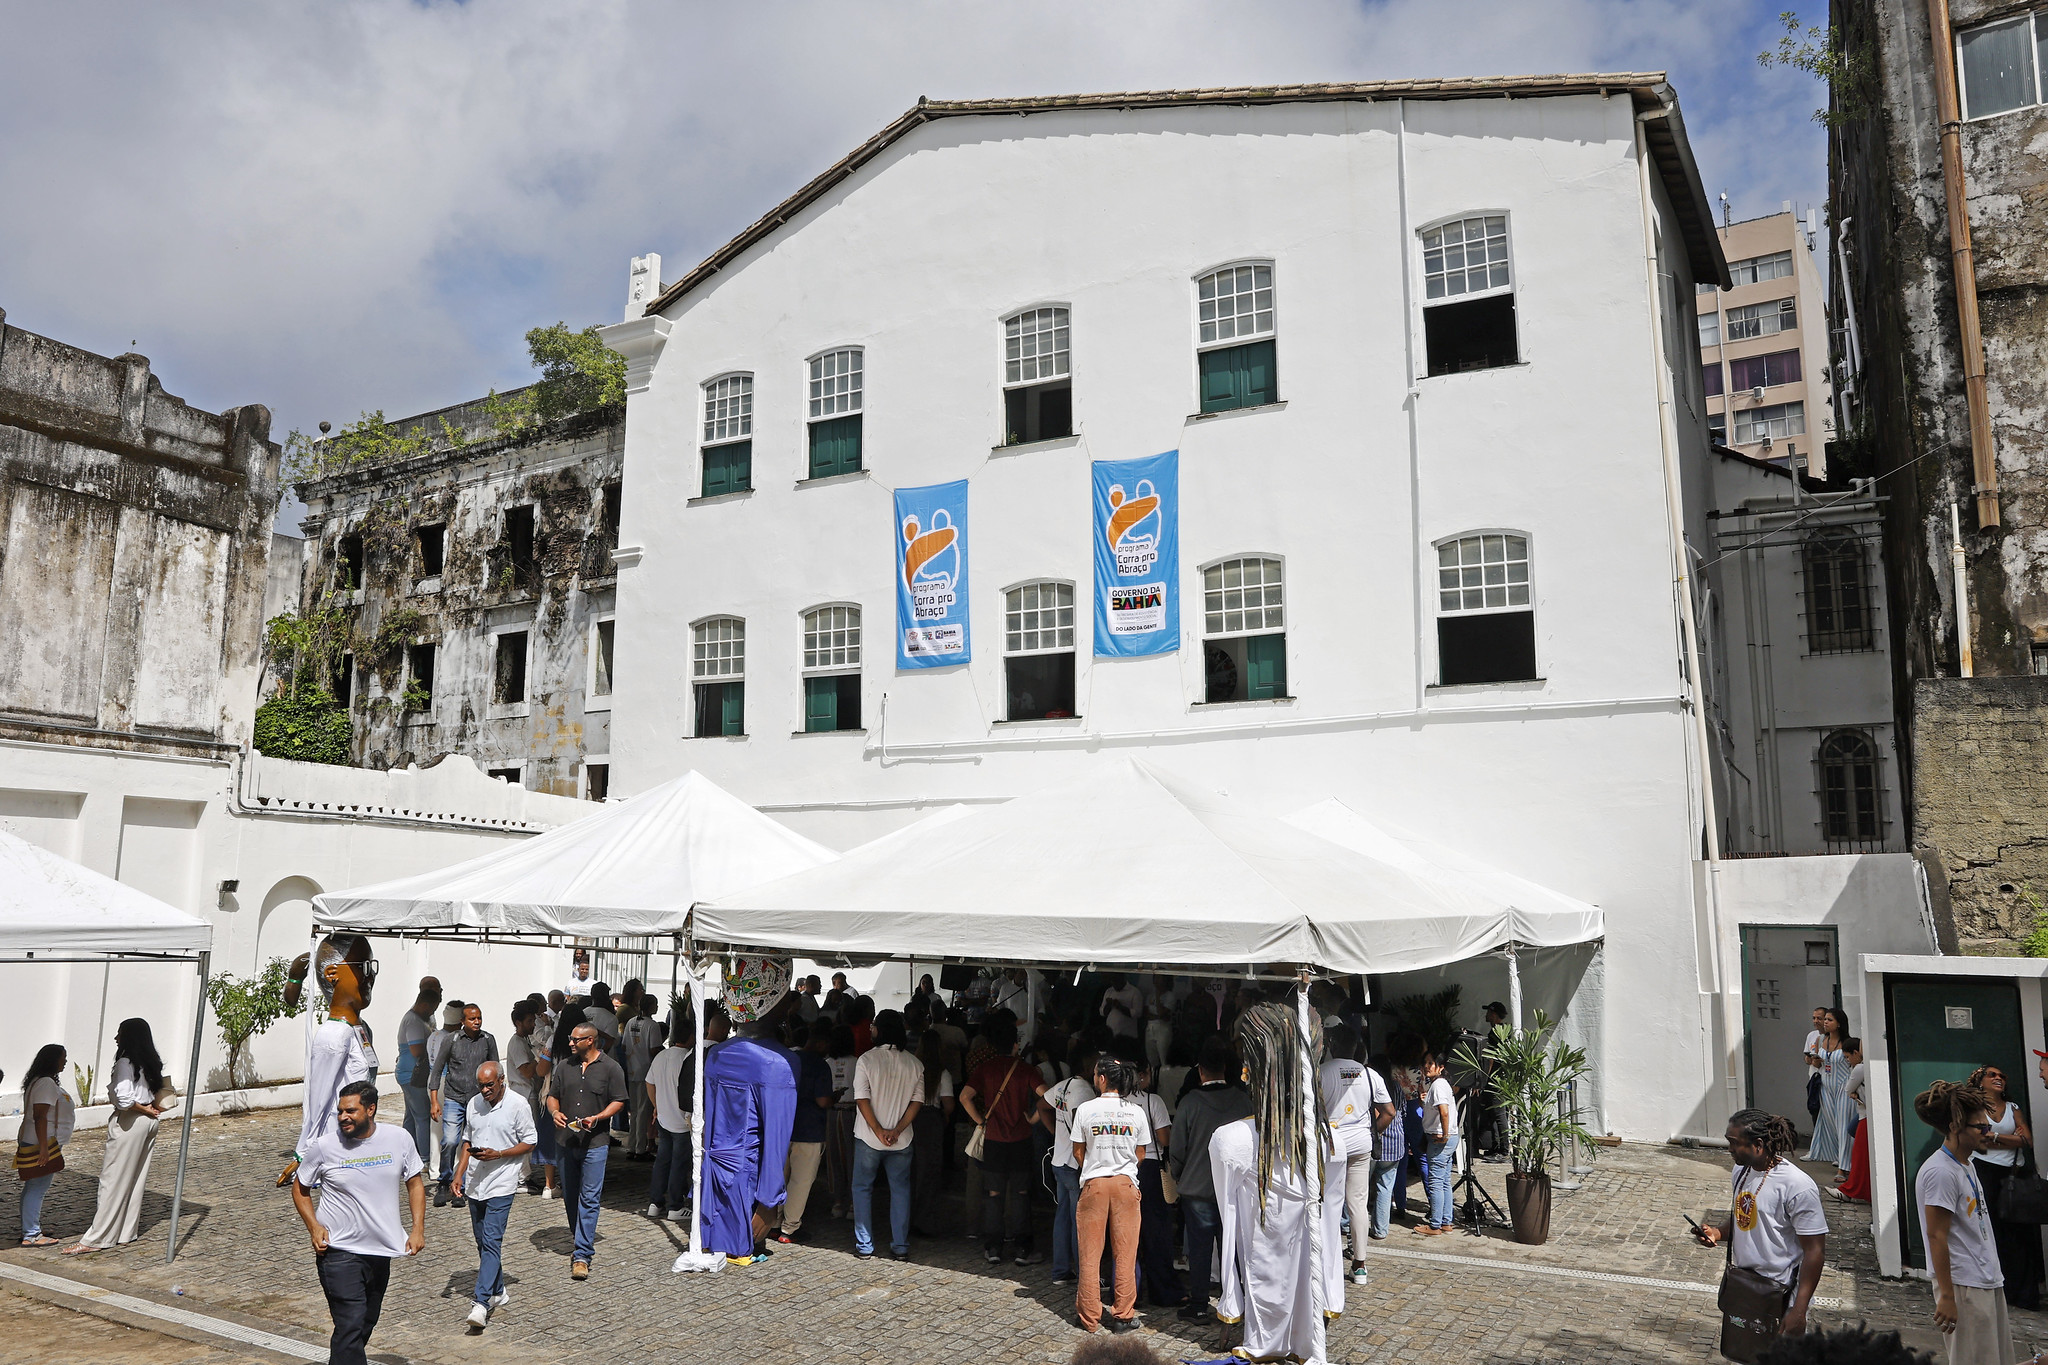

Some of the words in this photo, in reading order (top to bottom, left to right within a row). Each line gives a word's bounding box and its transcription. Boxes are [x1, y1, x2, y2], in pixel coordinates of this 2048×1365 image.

[1118, 543, 1149, 553] programa
[1118, 554, 1139, 564] Corra
[1142, 552, 1155, 563] pro
[1118, 564, 1147, 573] Abraço
[913, 583, 945, 593] programa
[1112, 587, 1148, 597] GOVERNO
[1151, 586, 1160, 594] DA
[914, 596, 935, 606] Corra
[938, 594, 952, 605] pro
[1112, 593, 1161, 610] BAHIA
[916, 607, 944, 617] Abraço
[1091, 1125, 1133, 1136] BAHIA
[341, 1154, 391, 1165] HORIZONTES
[355, 1159, 392, 1167] CUIDADO
